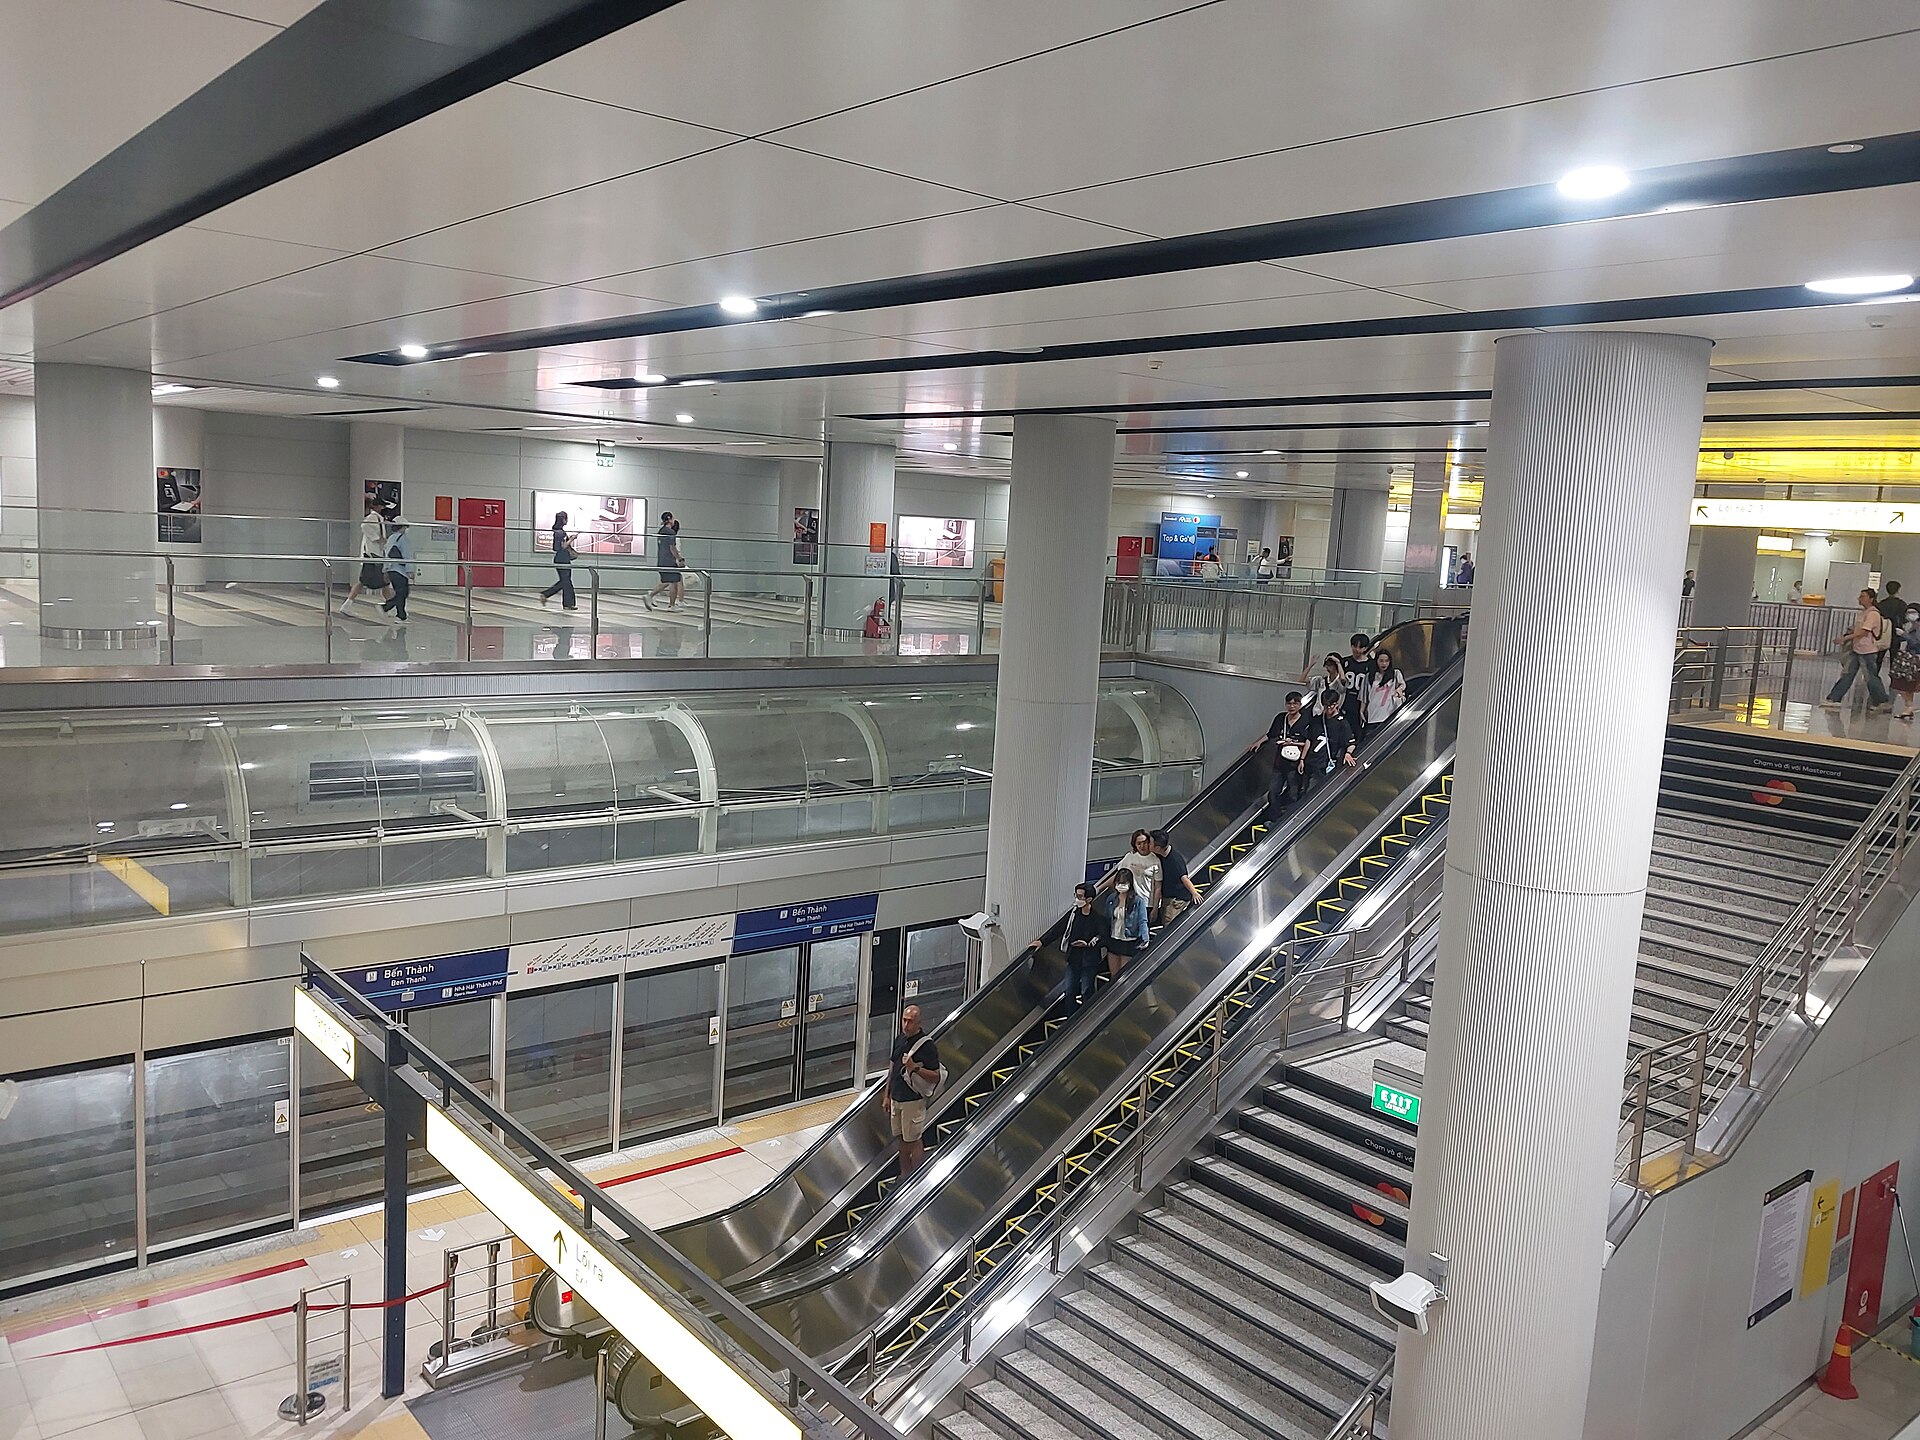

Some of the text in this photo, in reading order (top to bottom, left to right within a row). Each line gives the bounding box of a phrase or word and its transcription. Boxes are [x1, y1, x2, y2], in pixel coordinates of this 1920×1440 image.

[1753, 758, 1774, 767] Chạm
[1802, 765, 1842, 777] Mastercard
[792, 904, 828, 917] Bến Thành
[384, 963, 435, 979] Bến Thành
[390, 975, 427, 987] Ben Thanh
[1380, 1089, 1413, 1110] EXIT
[1364, 1138, 1386, 1152] Chạm
[1386, 1147, 1396, 1156] và
[593, 1264, 604, 1282] ra
